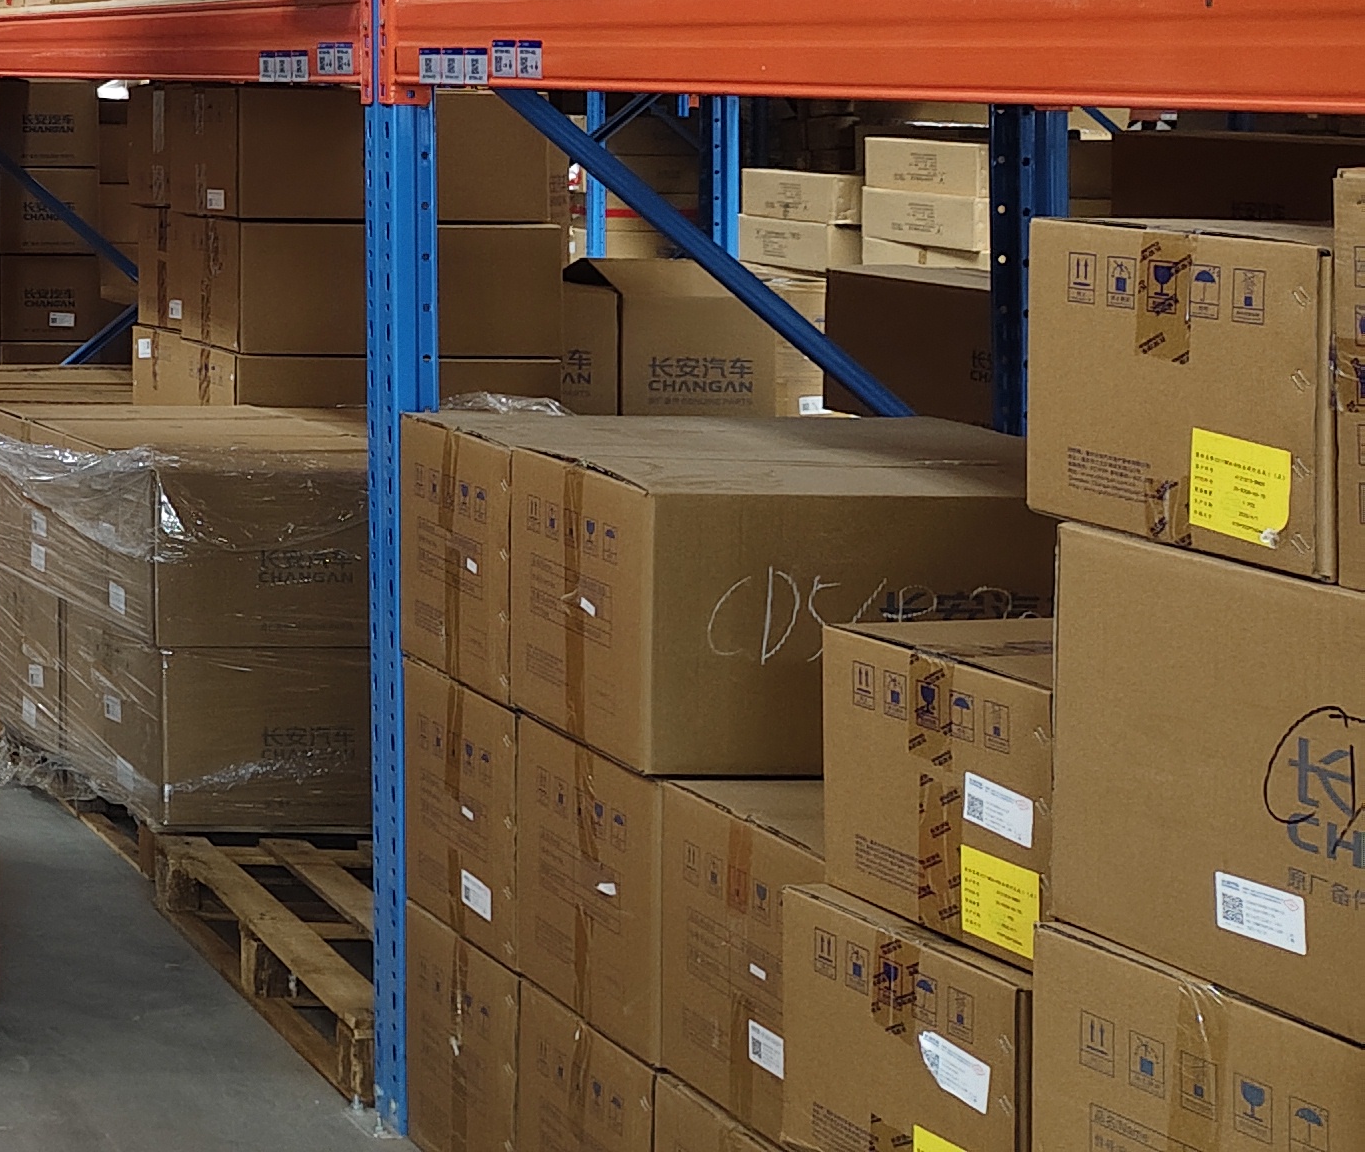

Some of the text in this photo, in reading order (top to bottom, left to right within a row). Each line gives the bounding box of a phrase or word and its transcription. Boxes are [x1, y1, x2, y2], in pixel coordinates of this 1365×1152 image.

[648, 356, 754, 379] 长安汽车
[647, 379, 754, 393] CHANGAN
